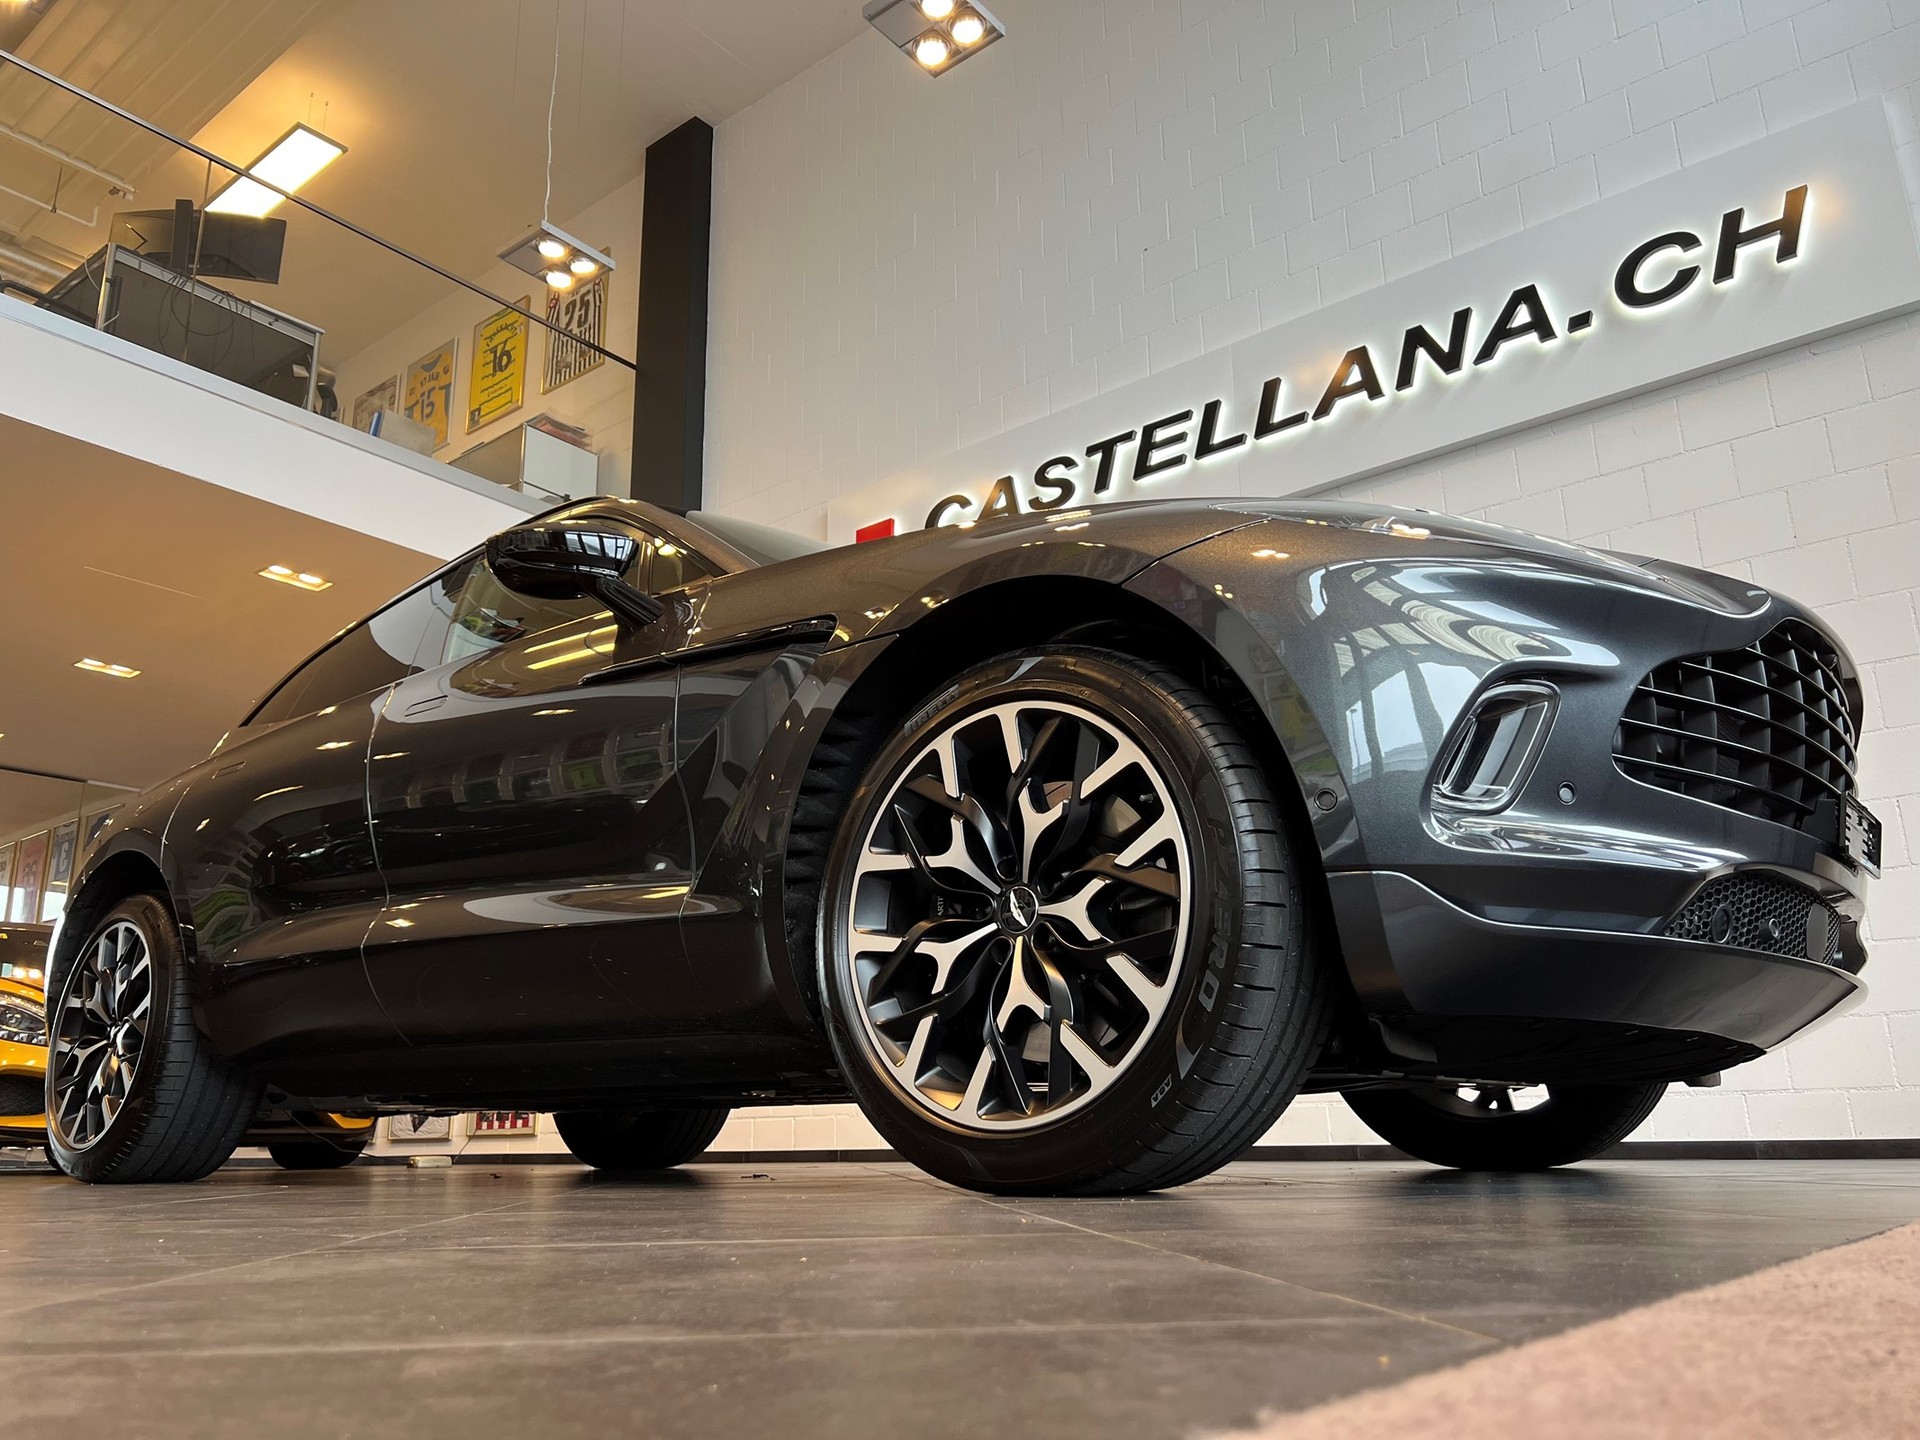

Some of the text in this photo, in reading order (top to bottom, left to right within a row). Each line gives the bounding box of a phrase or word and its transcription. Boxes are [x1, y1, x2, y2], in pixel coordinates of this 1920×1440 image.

[565, 289, 591, 331] 25
[489, 339, 512, 378] 16
[925, 184, 1808, 529] CASTELLANA.CH
[903, 684, 960, 737] PIRELLI
